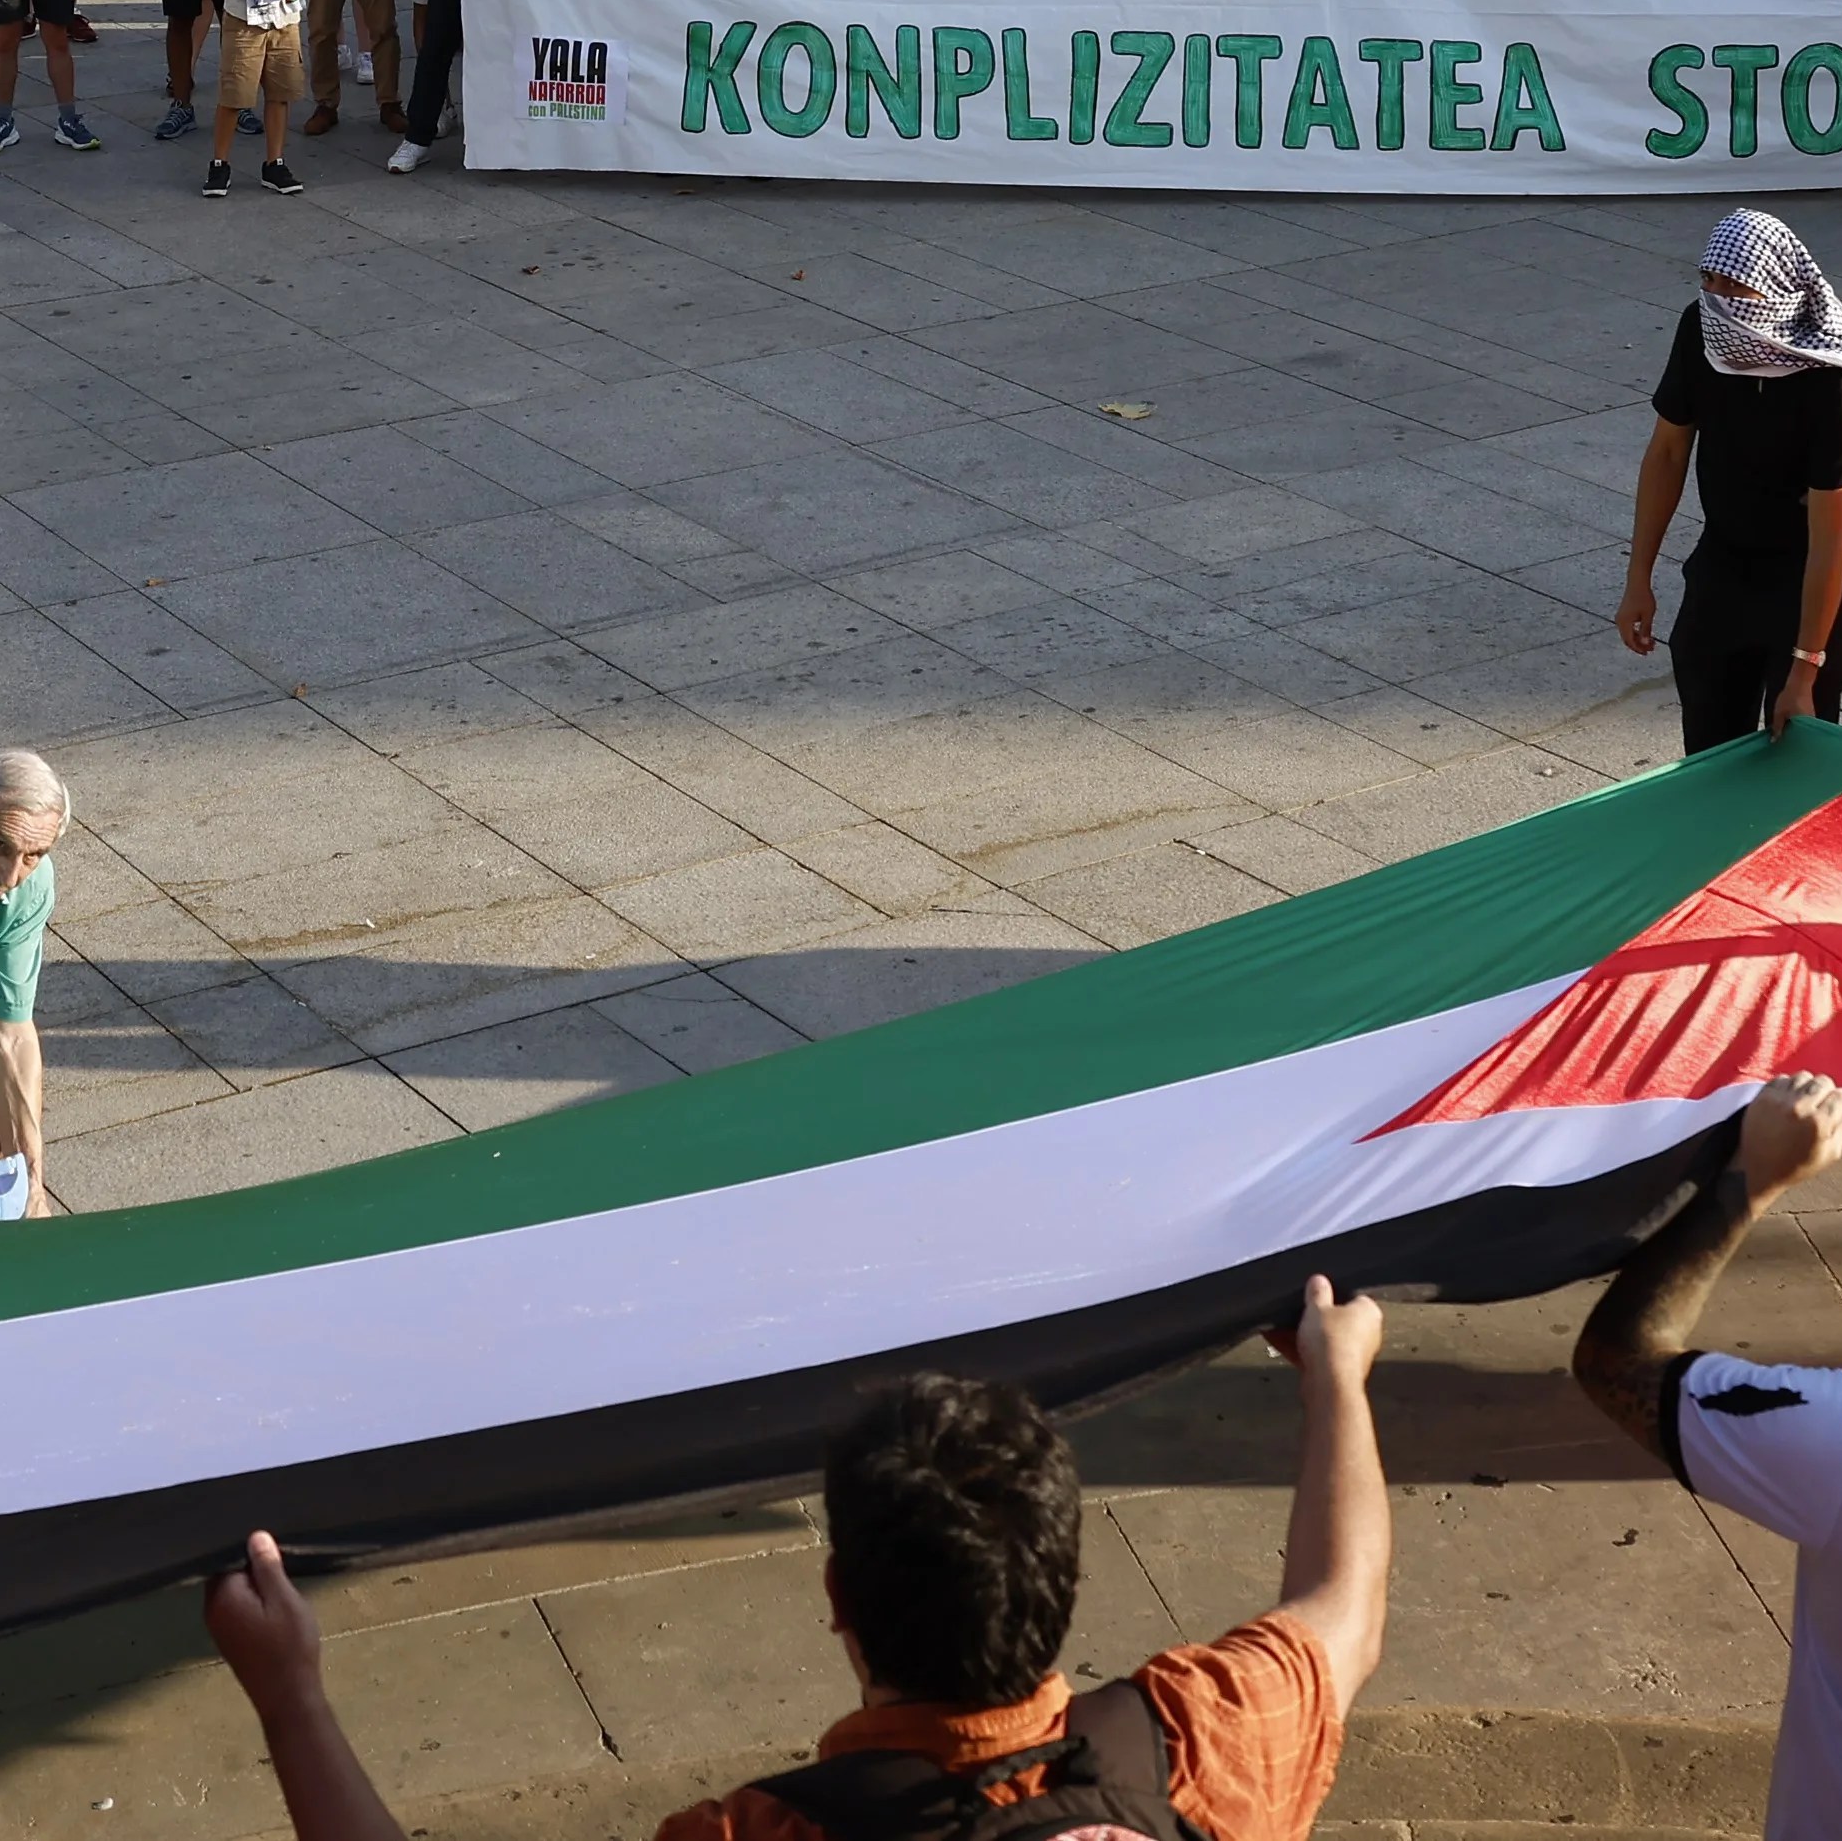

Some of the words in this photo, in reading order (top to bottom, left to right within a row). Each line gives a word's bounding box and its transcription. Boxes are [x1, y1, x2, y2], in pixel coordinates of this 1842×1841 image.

[532, 37, 608, 84] YALA
[529, 81, 605, 105] NAFARROA
[681, 20, 1566, 153] KONPLIZITATEA
[529, 105, 546, 117] con
[550, 102, 605, 120] PALESTINA
